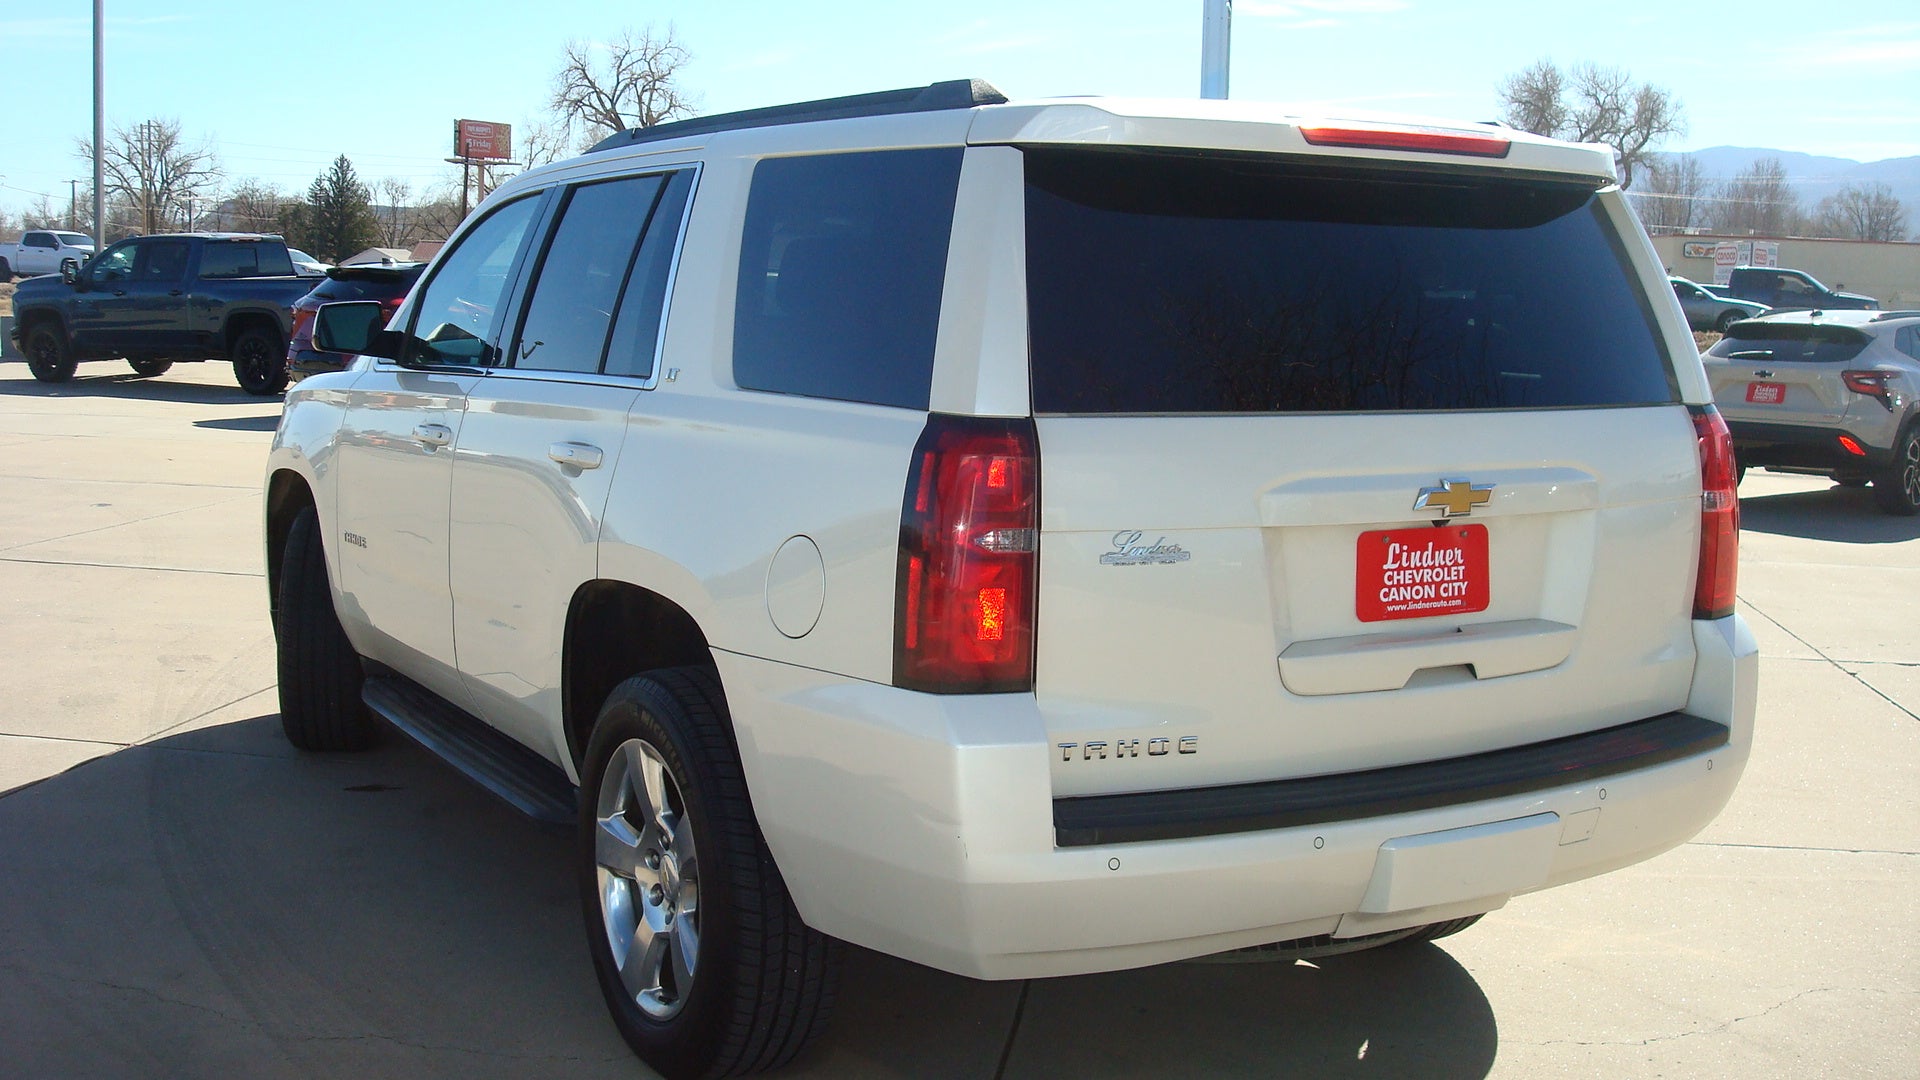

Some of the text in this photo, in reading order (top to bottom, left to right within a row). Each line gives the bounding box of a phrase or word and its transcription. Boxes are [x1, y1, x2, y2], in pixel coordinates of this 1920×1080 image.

[473, 139, 493, 150] Friday
[1382, 541, 1464, 570] Lindner
[1383, 565, 1466, 586] CHEVROLET
[1379, 581, 1469, 603] CANON CITY
[1386, 599, 1462, 612] www.lindnerauto.com
[1057, 735, 1199, 762] TAHOE
